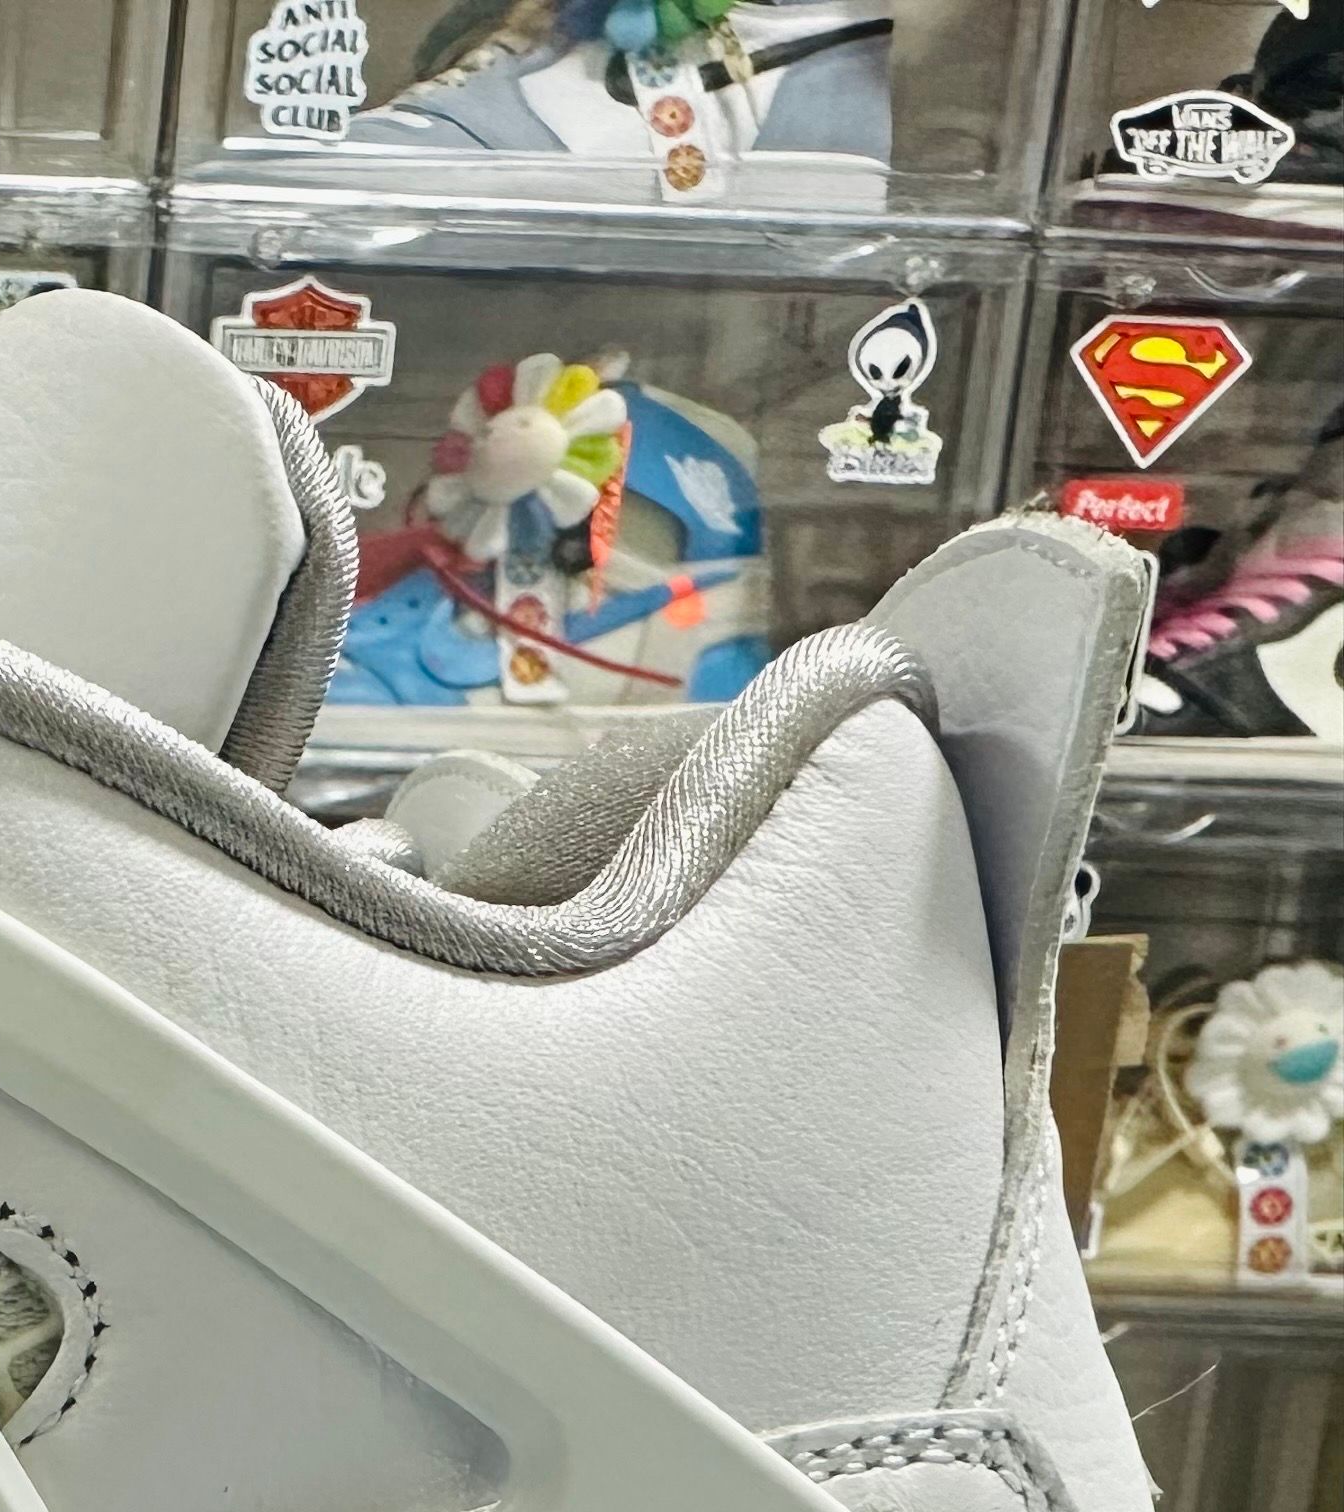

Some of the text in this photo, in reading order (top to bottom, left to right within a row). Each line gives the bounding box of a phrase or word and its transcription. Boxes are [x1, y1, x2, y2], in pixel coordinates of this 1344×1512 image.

[256, 28, 358, 63] SOCIAL
[254, 64, 358, 97] SOCIAL
[271, 104, 343, 133] CLUB
